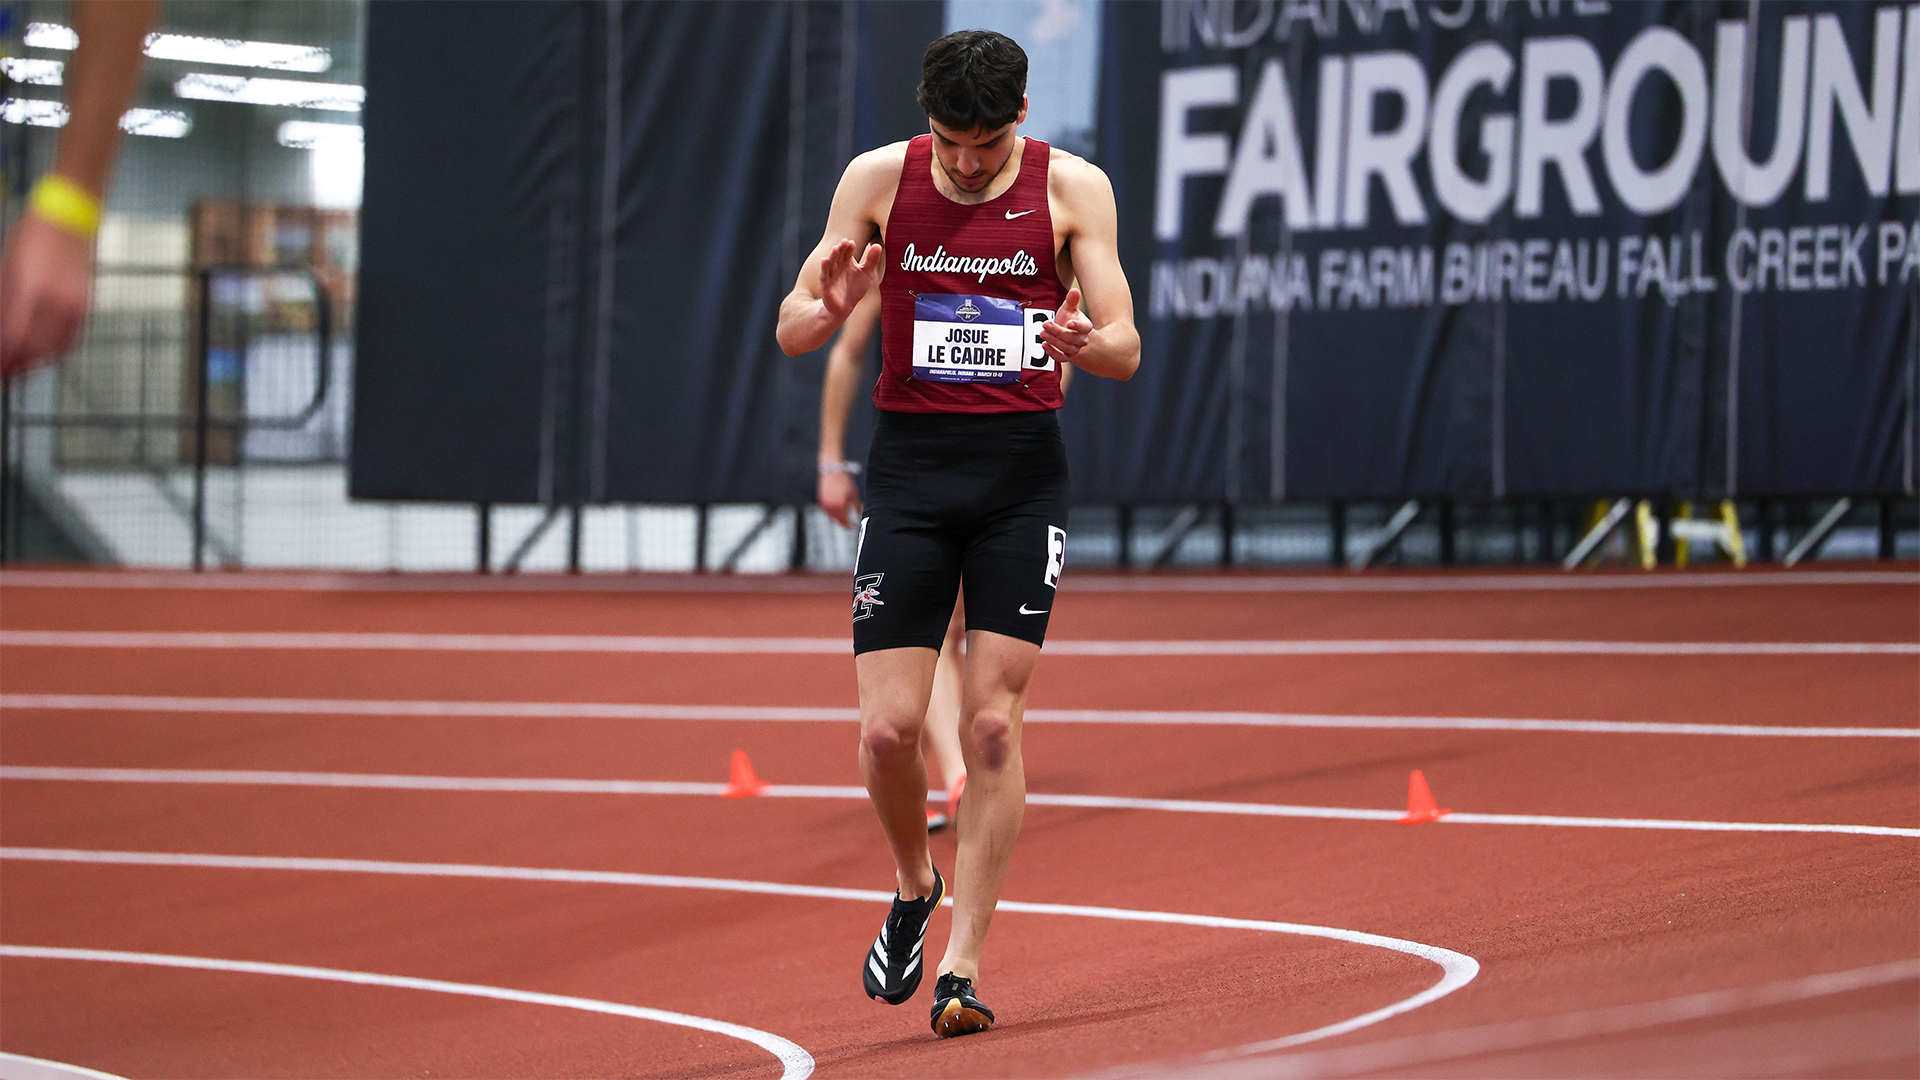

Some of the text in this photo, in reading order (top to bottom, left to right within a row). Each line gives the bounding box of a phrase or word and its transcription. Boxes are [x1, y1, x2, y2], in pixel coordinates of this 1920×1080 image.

[1154, 6, 1920, 240] FAIRGROUN
[900, 242, 1038, 283] Indianapolis
[1725, 222, 1868, 293] CREEK
[928, 345, 1006, 366] LE CADRE
[945, 328, 989, 344] JOSUE
